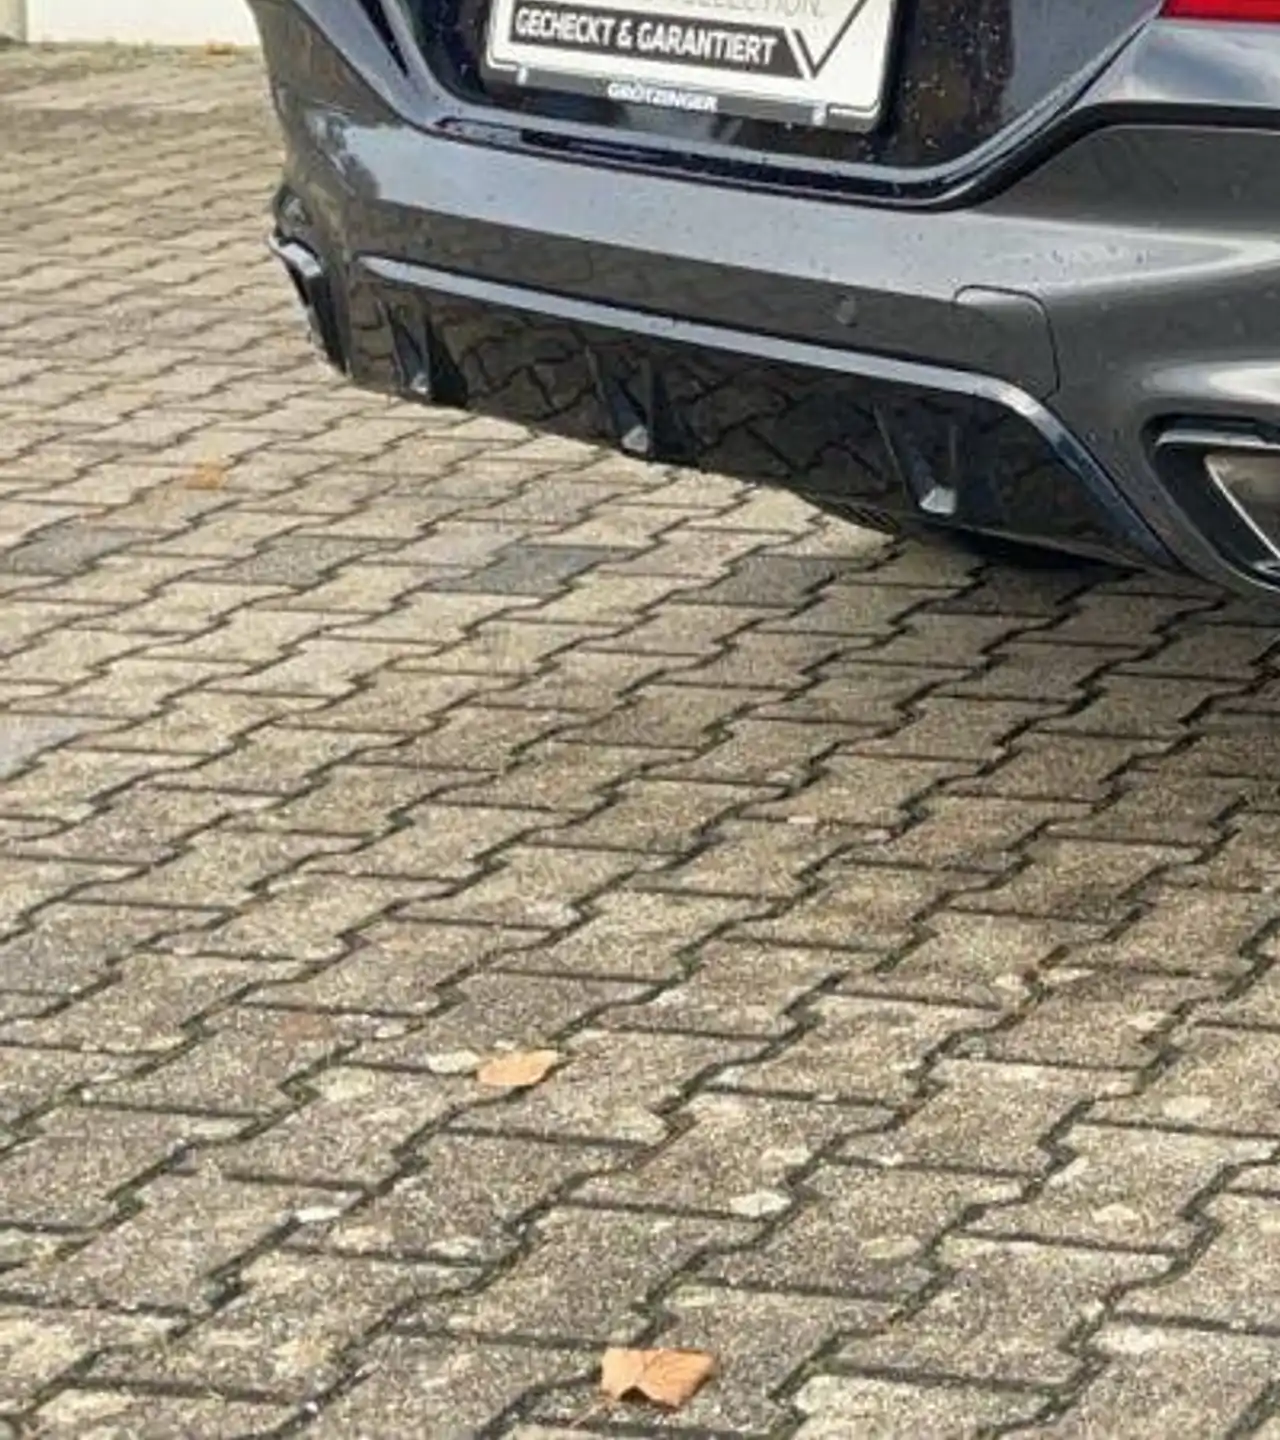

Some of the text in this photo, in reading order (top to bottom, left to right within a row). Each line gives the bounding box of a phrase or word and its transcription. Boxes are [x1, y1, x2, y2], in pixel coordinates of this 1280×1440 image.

[514, 7, 779, 66] GECHECKT & GARANTIERT
